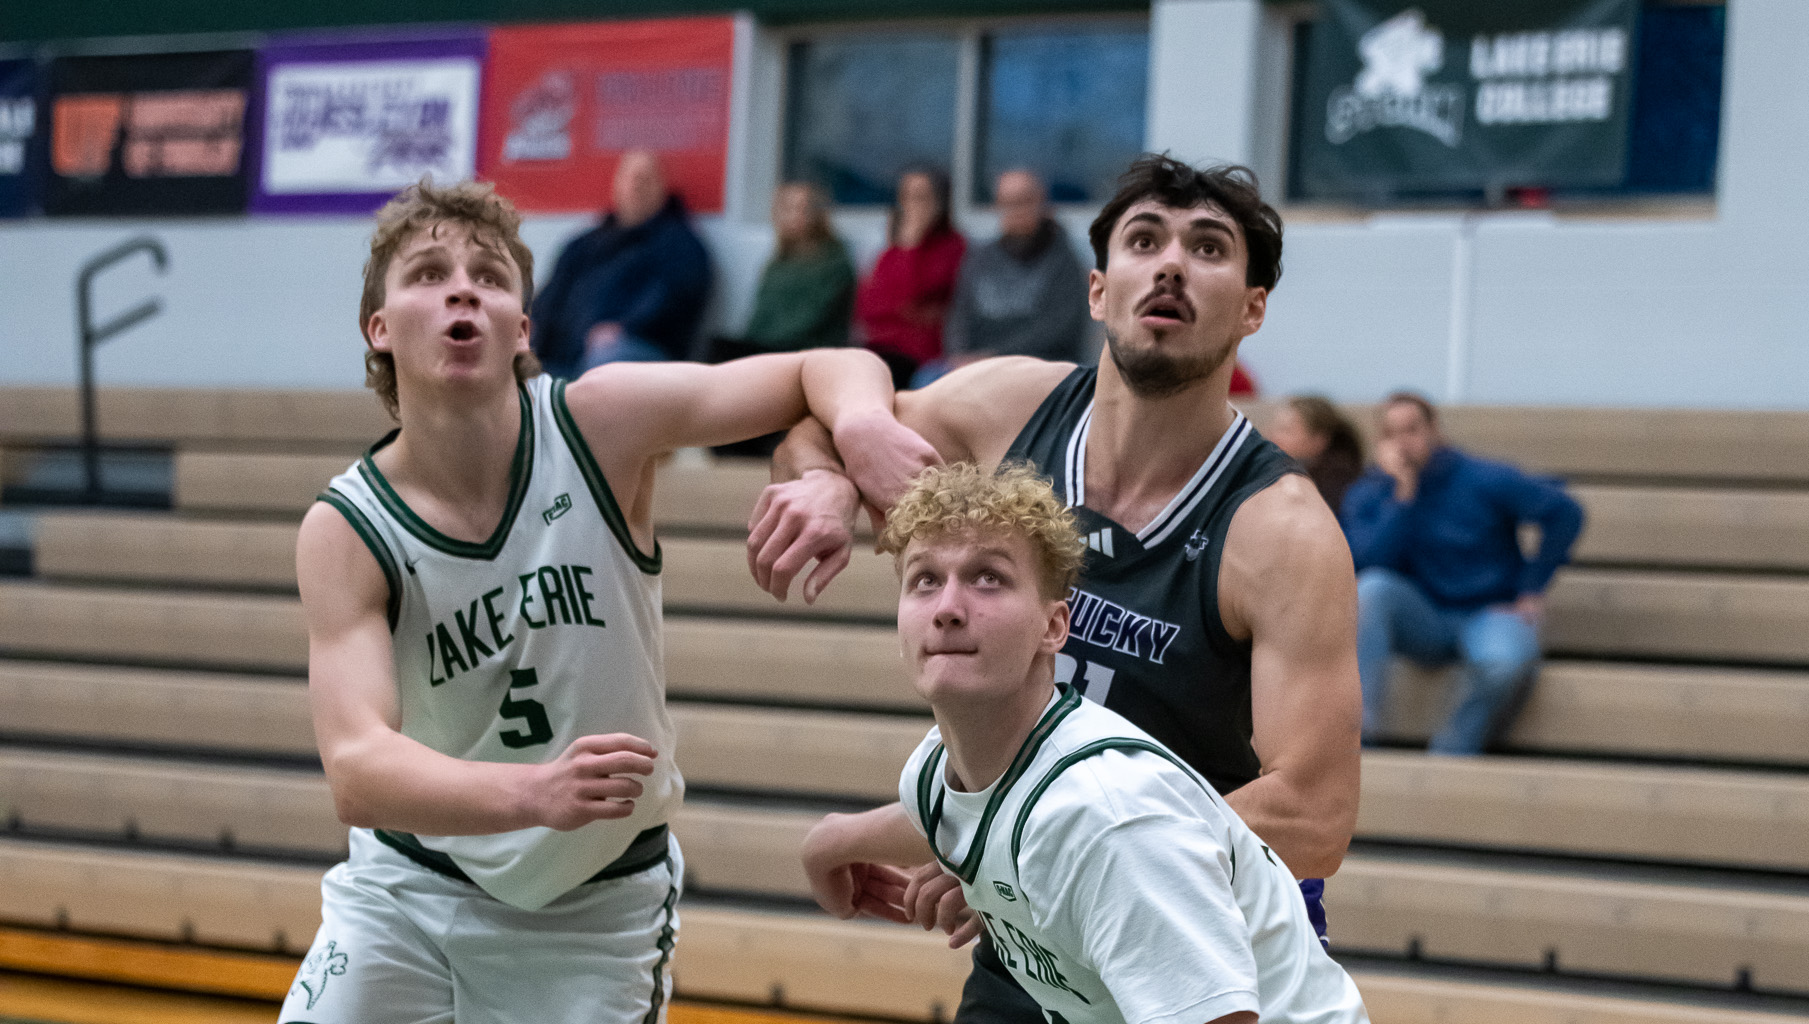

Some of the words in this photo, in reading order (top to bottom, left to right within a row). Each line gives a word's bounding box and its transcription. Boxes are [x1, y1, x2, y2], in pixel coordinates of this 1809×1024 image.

[426, 586, 515, 687] LAKE
[518, 564, 606, 630] ERIE
[1065, 586, 1180, 665] UCKY
[499, 667, 553, 749] 5
[1000, 918, 1091, 1005] ERIE
